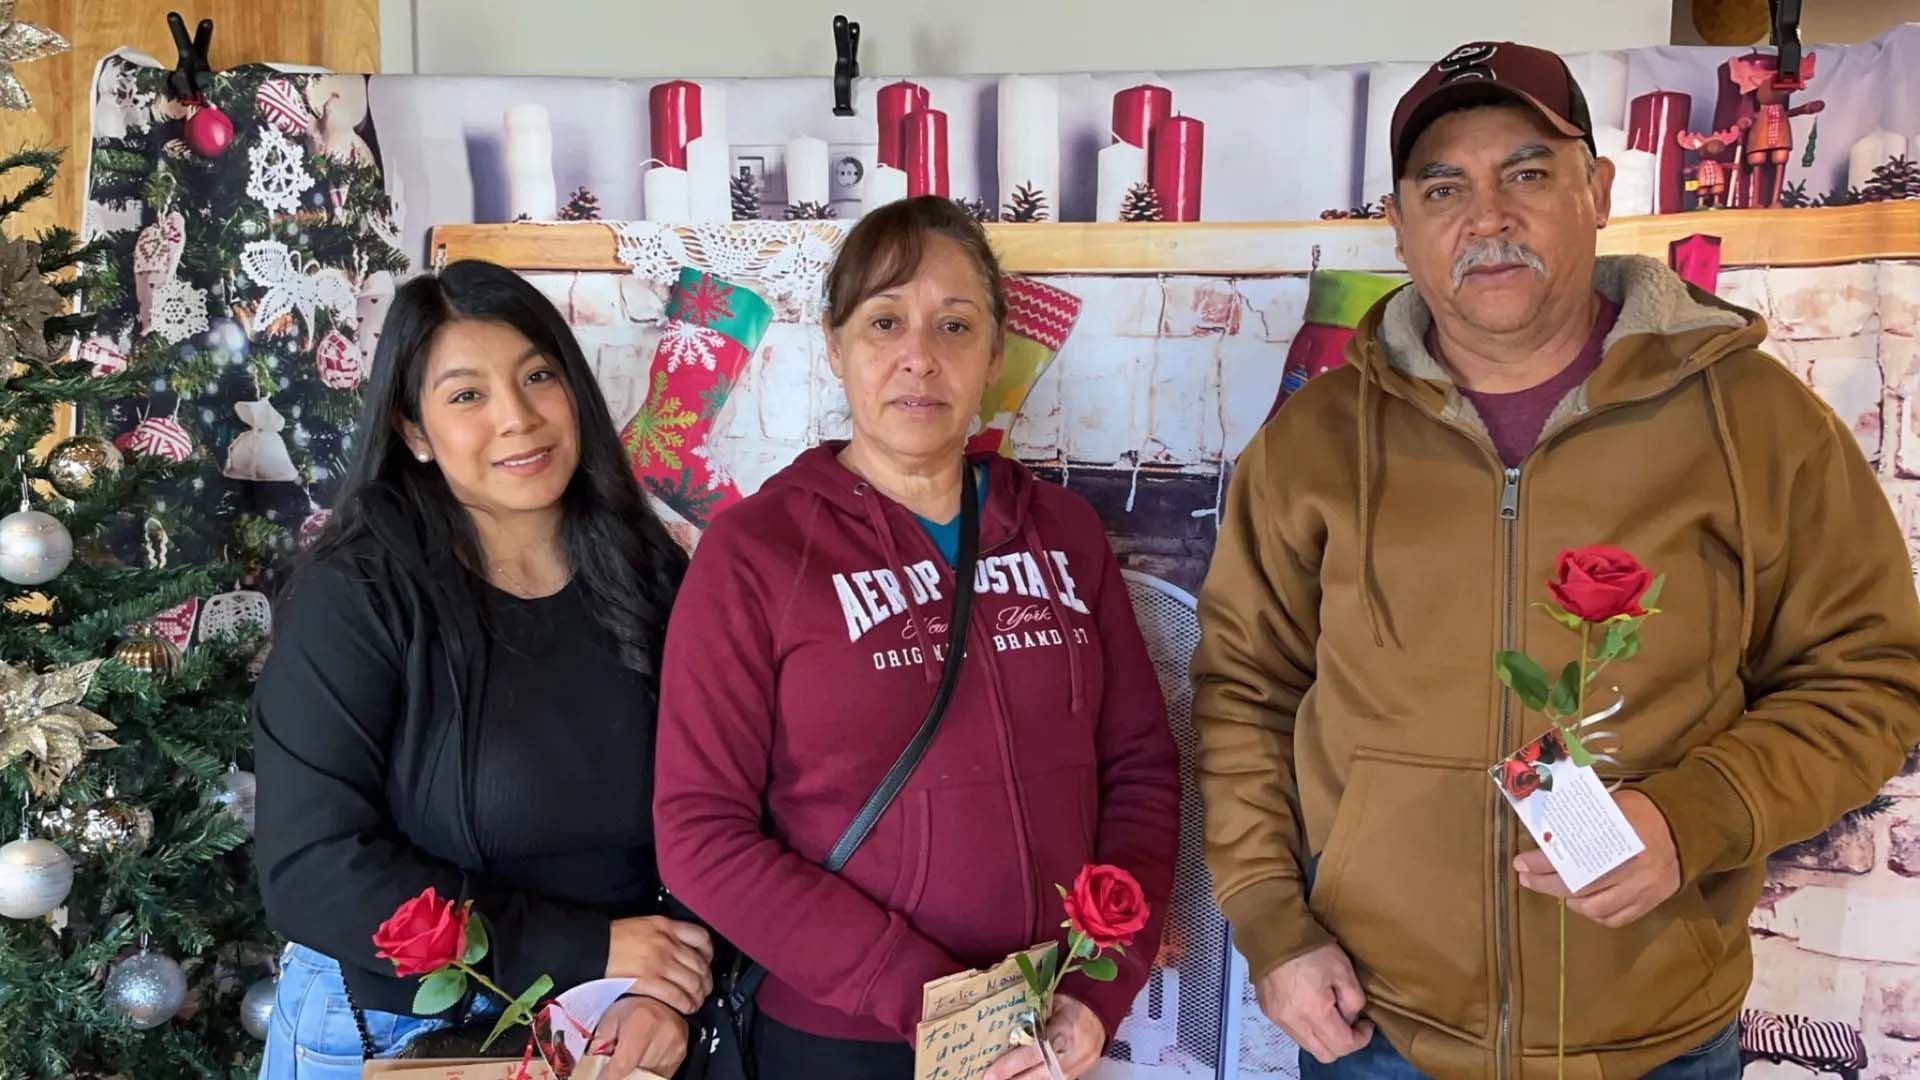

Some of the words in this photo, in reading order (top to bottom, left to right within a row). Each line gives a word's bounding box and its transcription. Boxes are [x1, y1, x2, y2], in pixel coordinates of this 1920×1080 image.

[996, 604, 1052, 631] York
[873, 643, 967, 670] ORIGN
[993, 629, 1062, 652] BRAND
